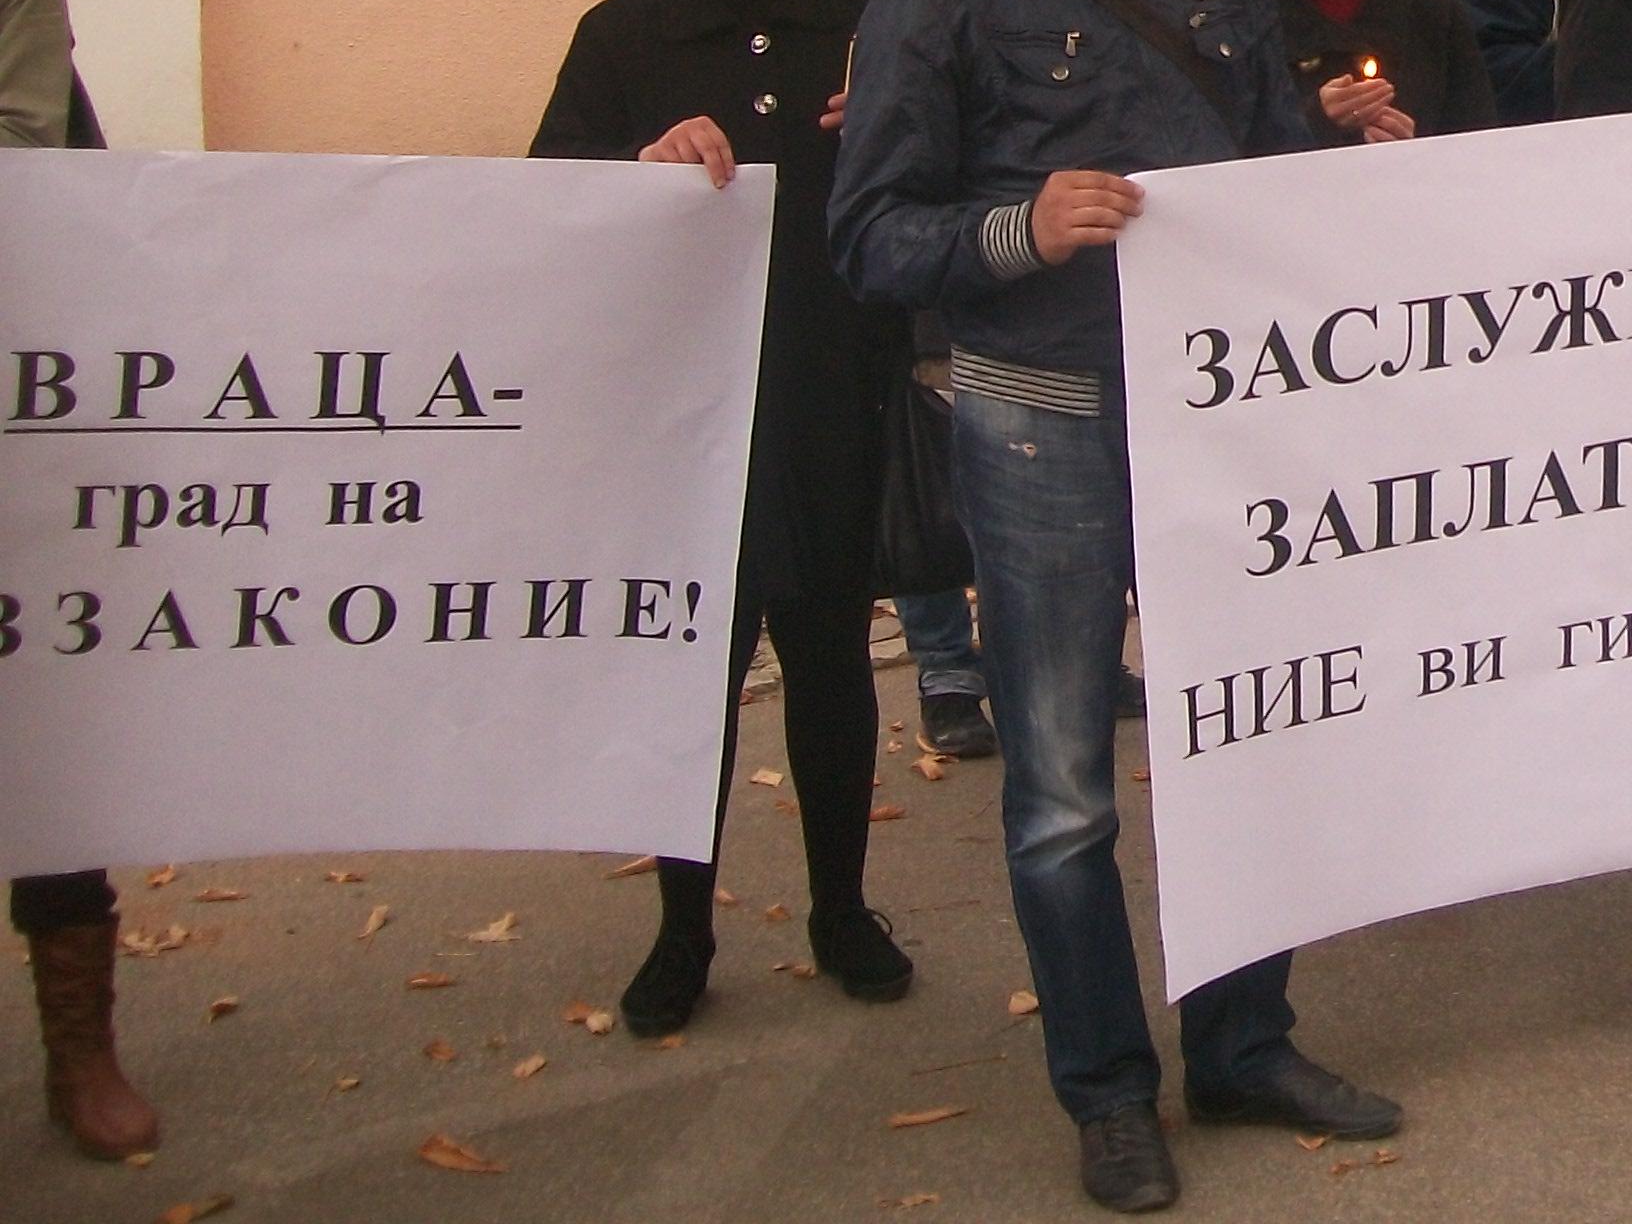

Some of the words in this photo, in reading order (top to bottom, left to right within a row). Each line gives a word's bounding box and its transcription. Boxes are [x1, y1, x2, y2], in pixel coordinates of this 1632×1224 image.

[71, 482, 271, 549] град
[325, 478, 424, 526] на
[1180, 644, 1367, 760] НИЕ
[1416, 635, 1508, 699] ви
